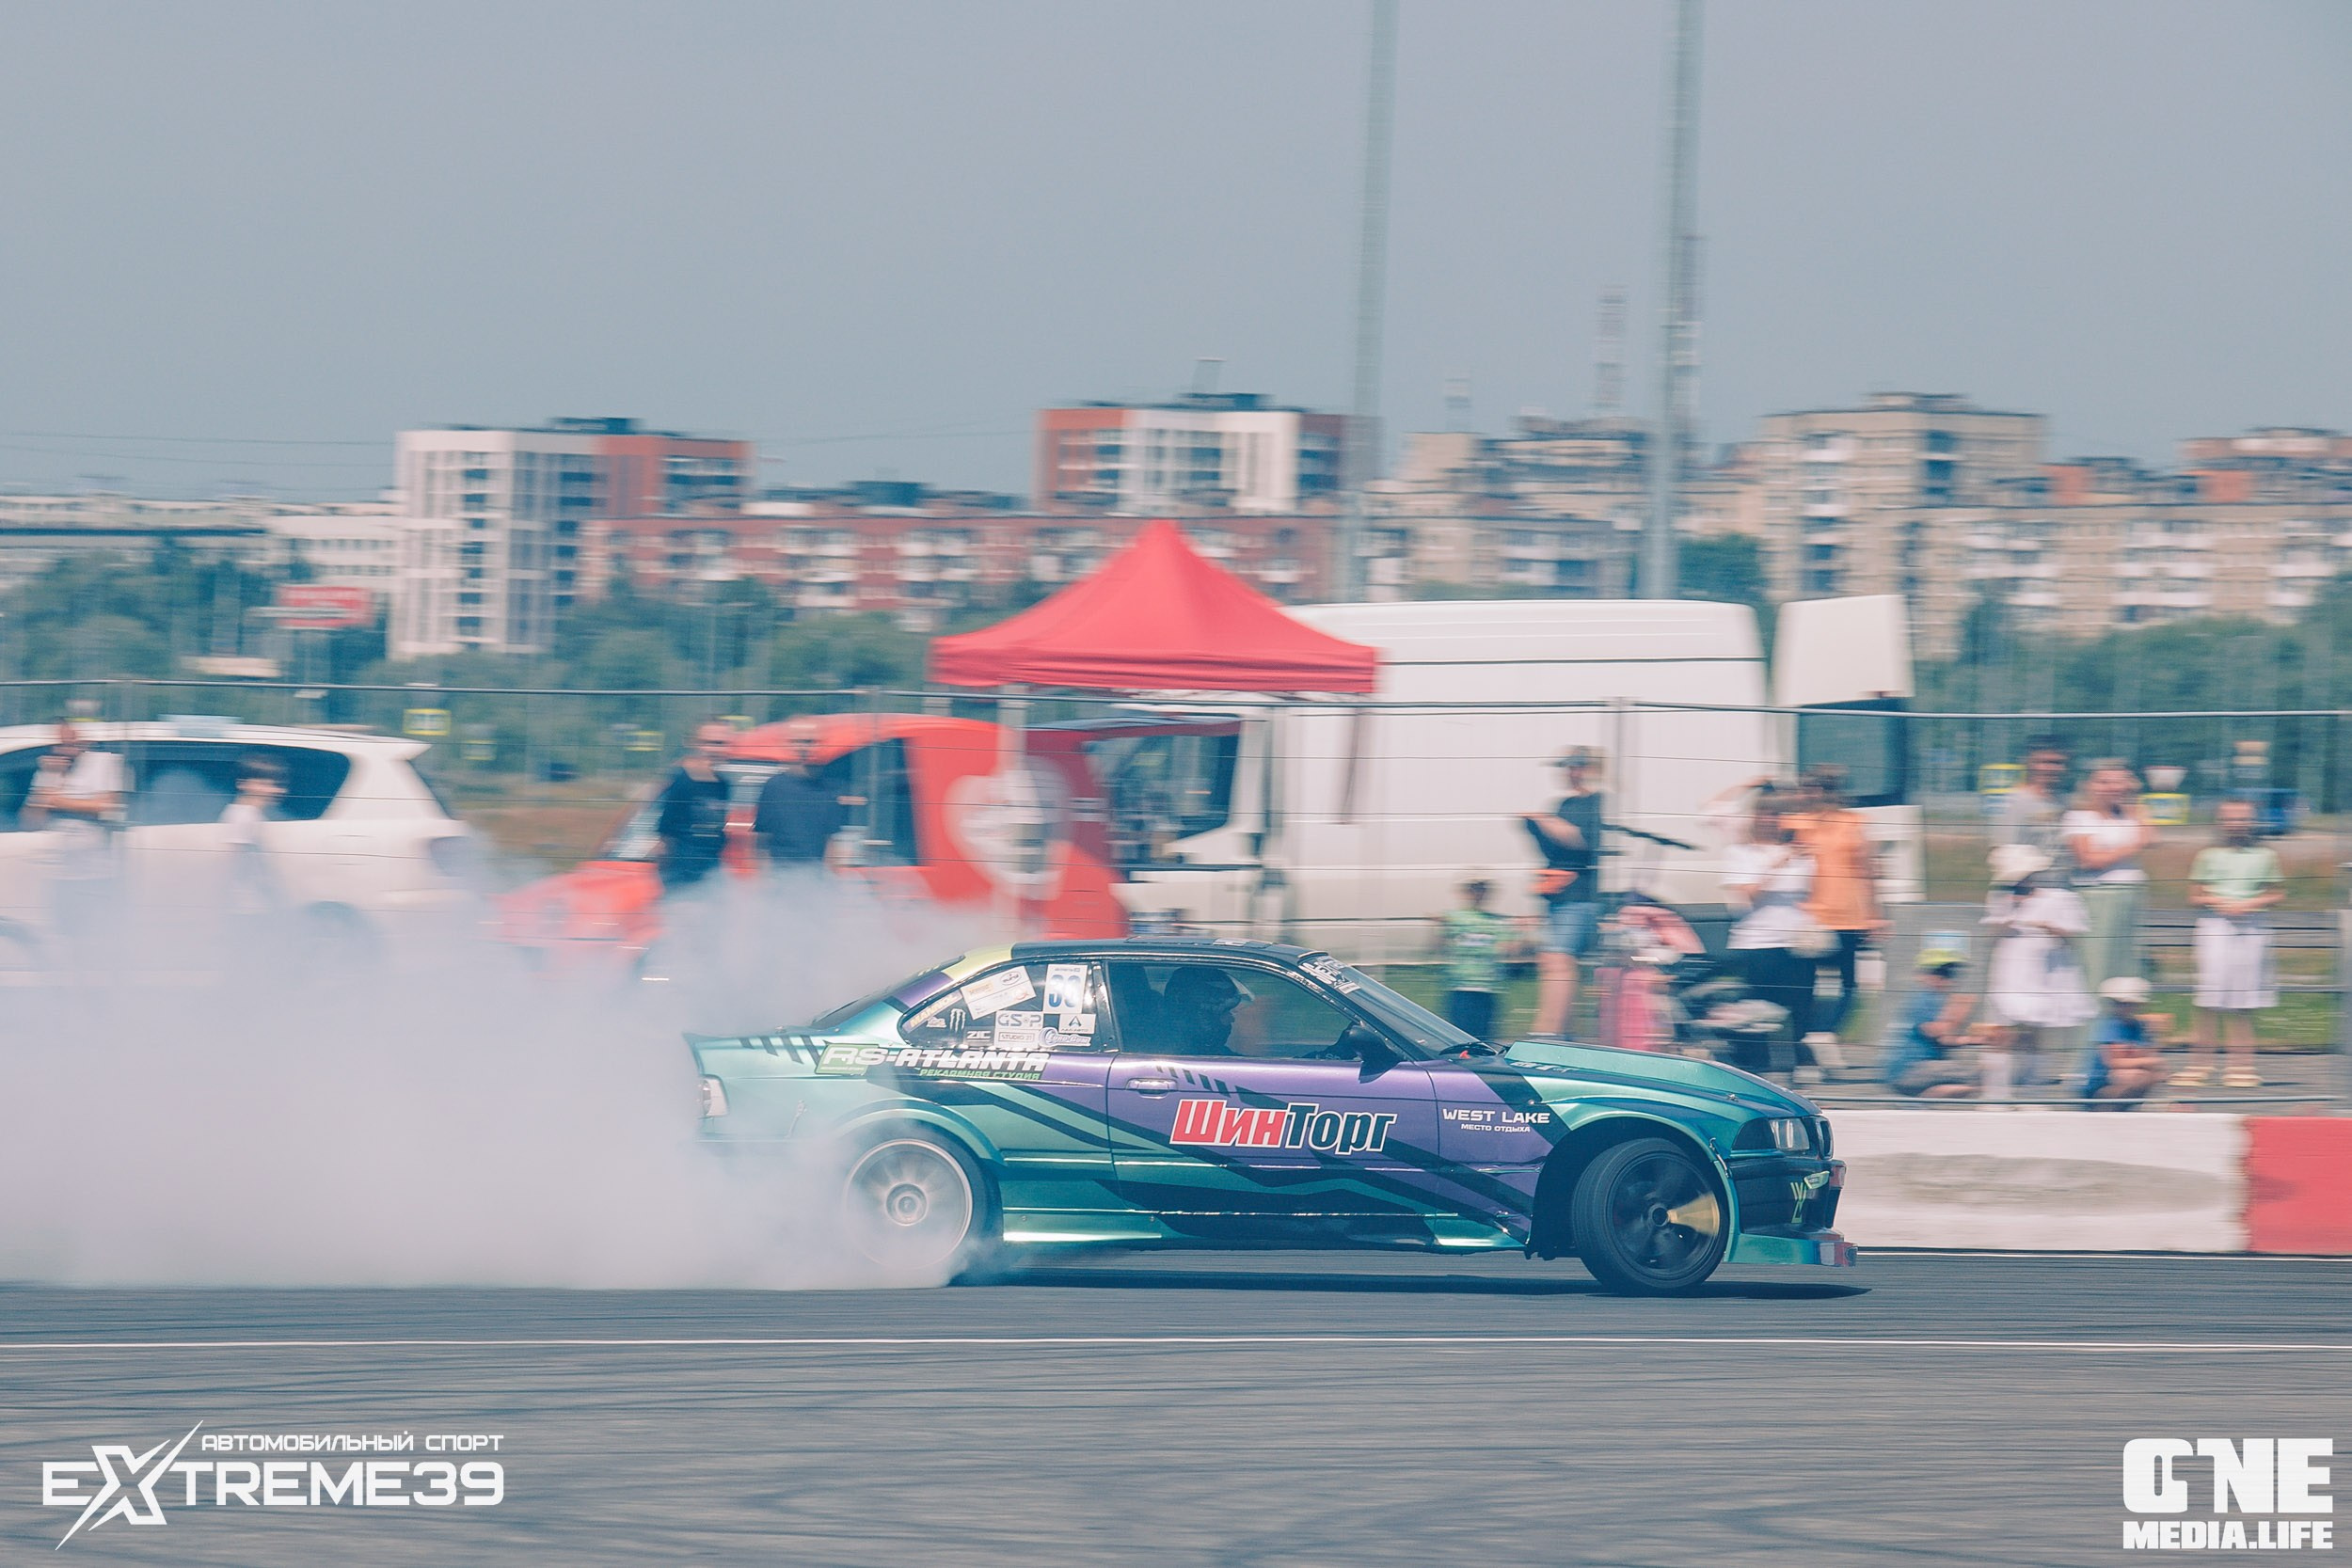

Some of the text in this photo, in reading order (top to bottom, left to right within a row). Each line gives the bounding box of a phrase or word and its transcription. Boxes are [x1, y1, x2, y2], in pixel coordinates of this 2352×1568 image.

[822, 1047, 1051, 1071] RS-ATLANTA
[1443, 1109, 1550, 1123] WEST LAKE
